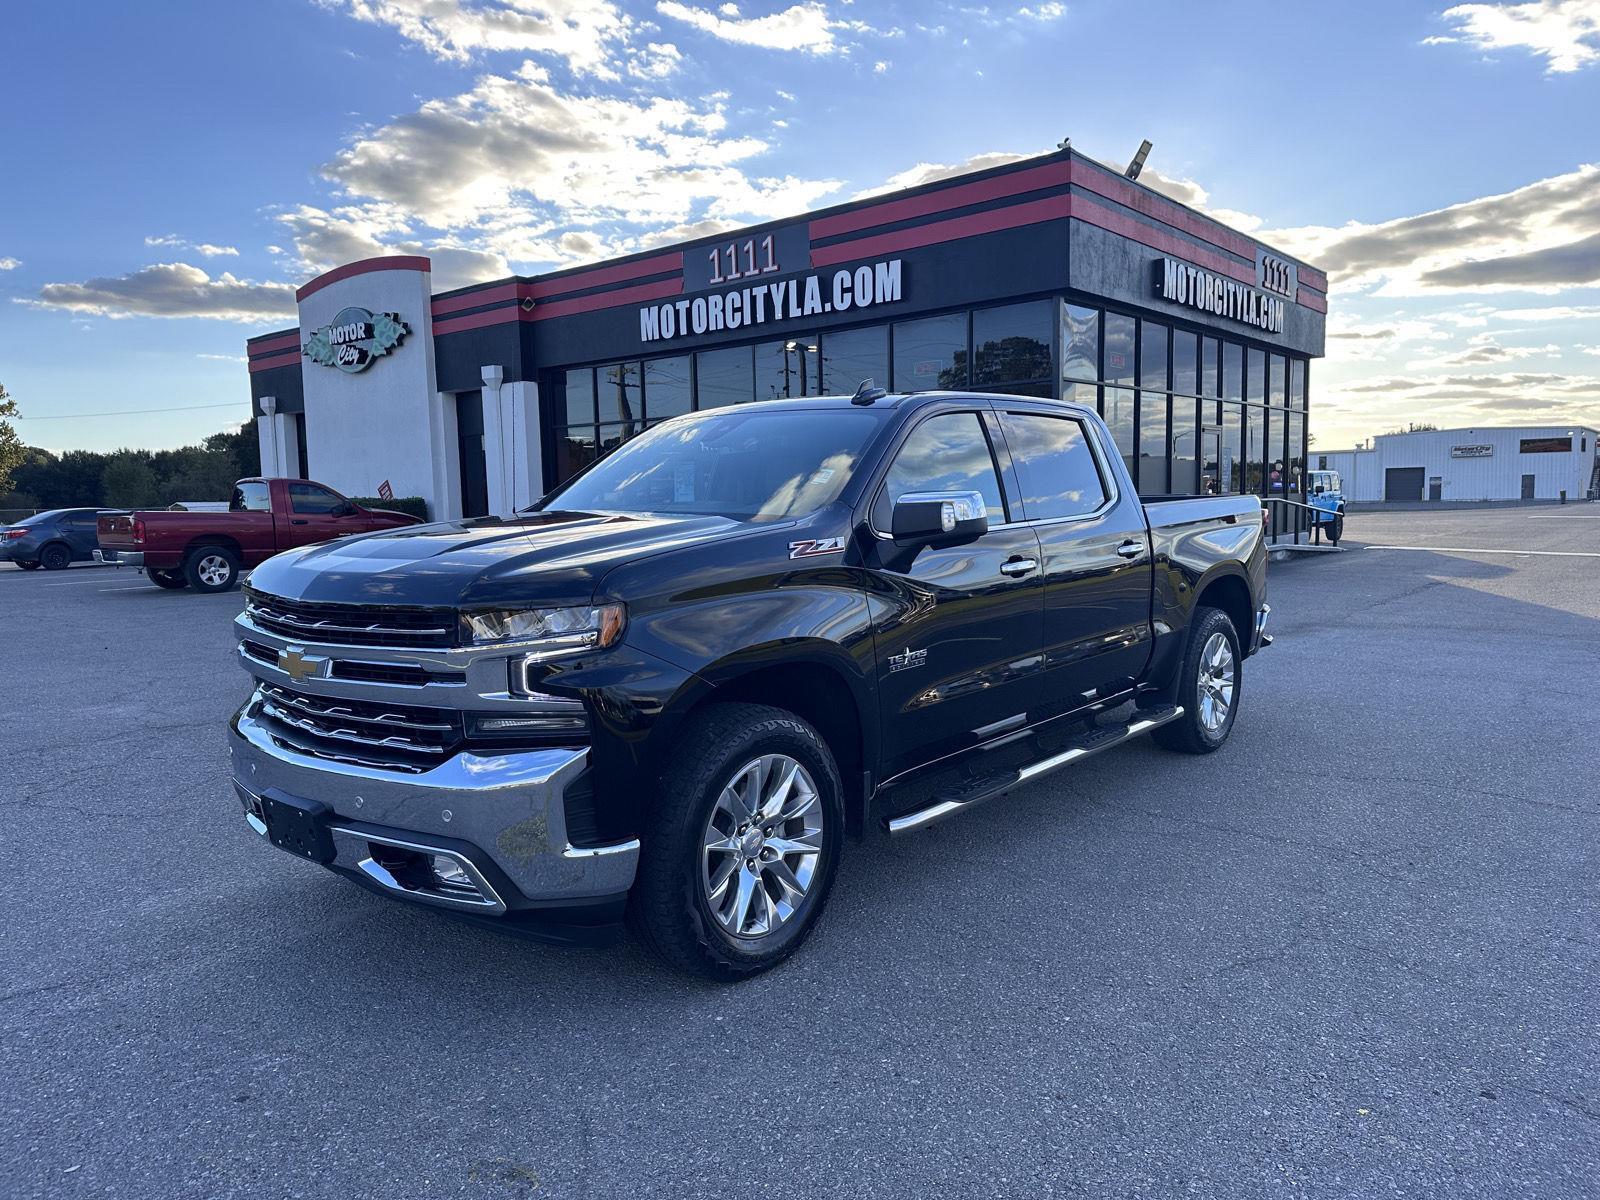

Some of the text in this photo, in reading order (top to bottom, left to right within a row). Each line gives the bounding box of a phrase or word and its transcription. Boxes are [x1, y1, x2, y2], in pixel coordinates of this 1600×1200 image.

[709, 234, 781, 284] 1111
[1262, 255, 1292, 297] 1111
[640, 259, 902, 342] MOTORCITYLA.COM
[1163, 257, 1284, 334] MOTORCITYLA.COM
[328, 322, 366, 345] MOTOR
[337, 344, 360, 365] City
[788, 536, 846, 560] Z71
